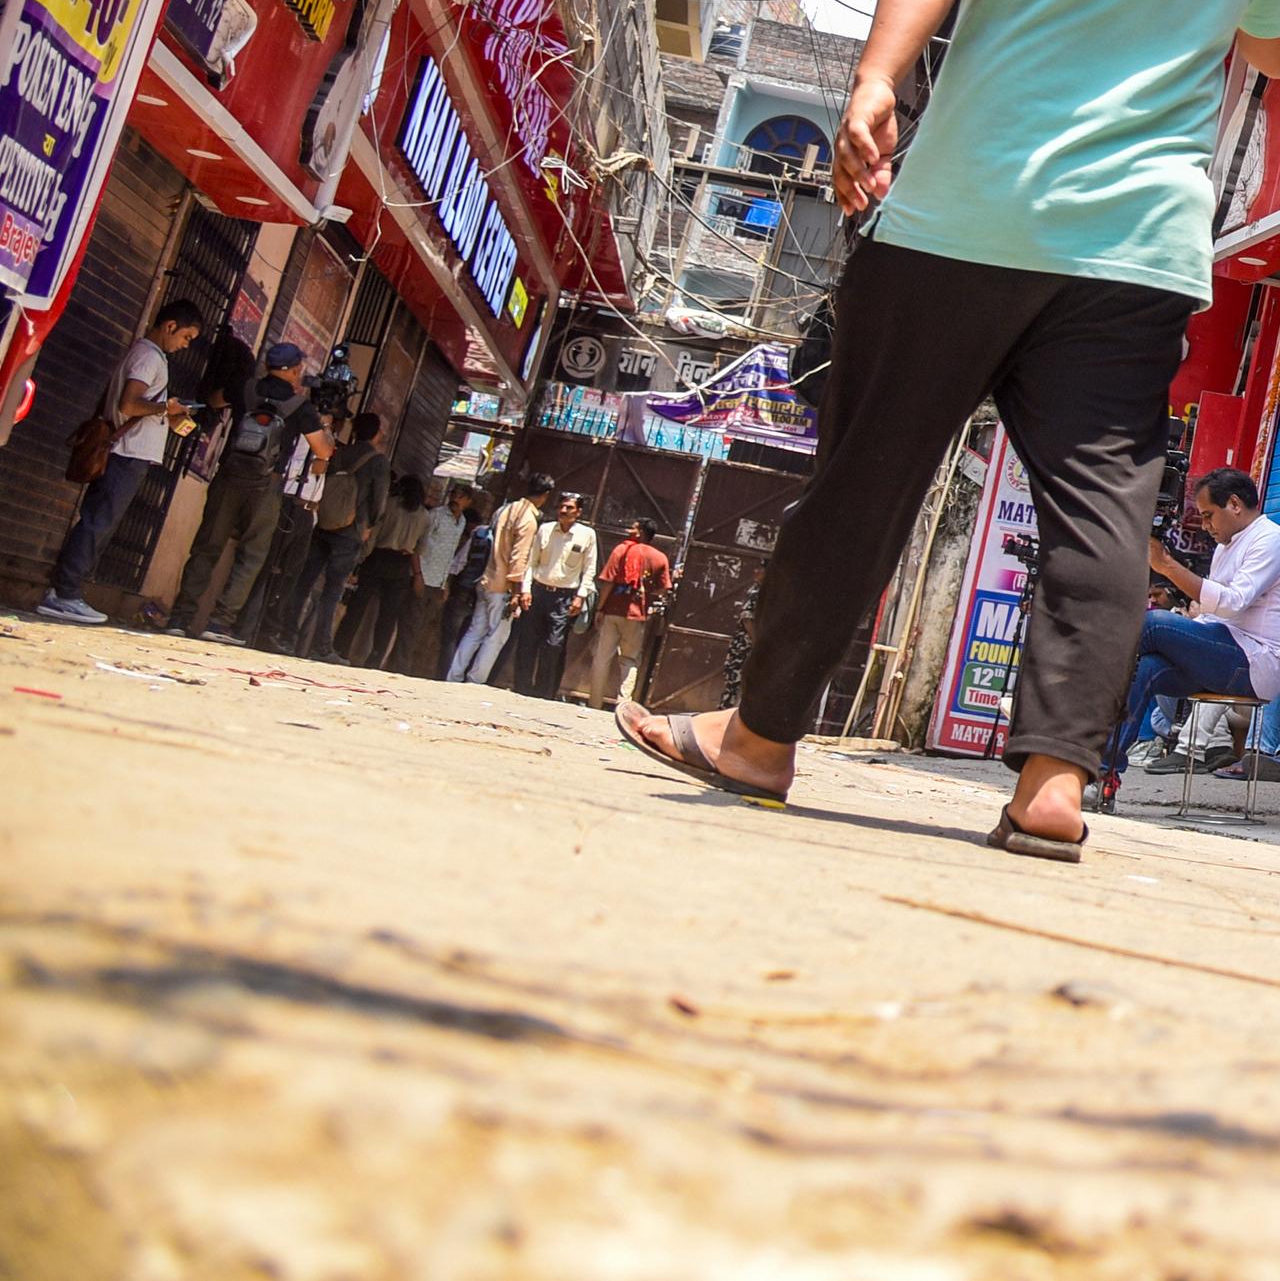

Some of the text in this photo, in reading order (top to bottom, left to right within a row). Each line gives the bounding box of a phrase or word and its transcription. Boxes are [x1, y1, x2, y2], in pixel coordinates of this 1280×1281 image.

[0, 23, 62, 130] POKEN
[403, 55, 468, 200] KHAN
[437, 156, 492, 261] BLOOD
[969, 640, 1021, 664] FOUN
